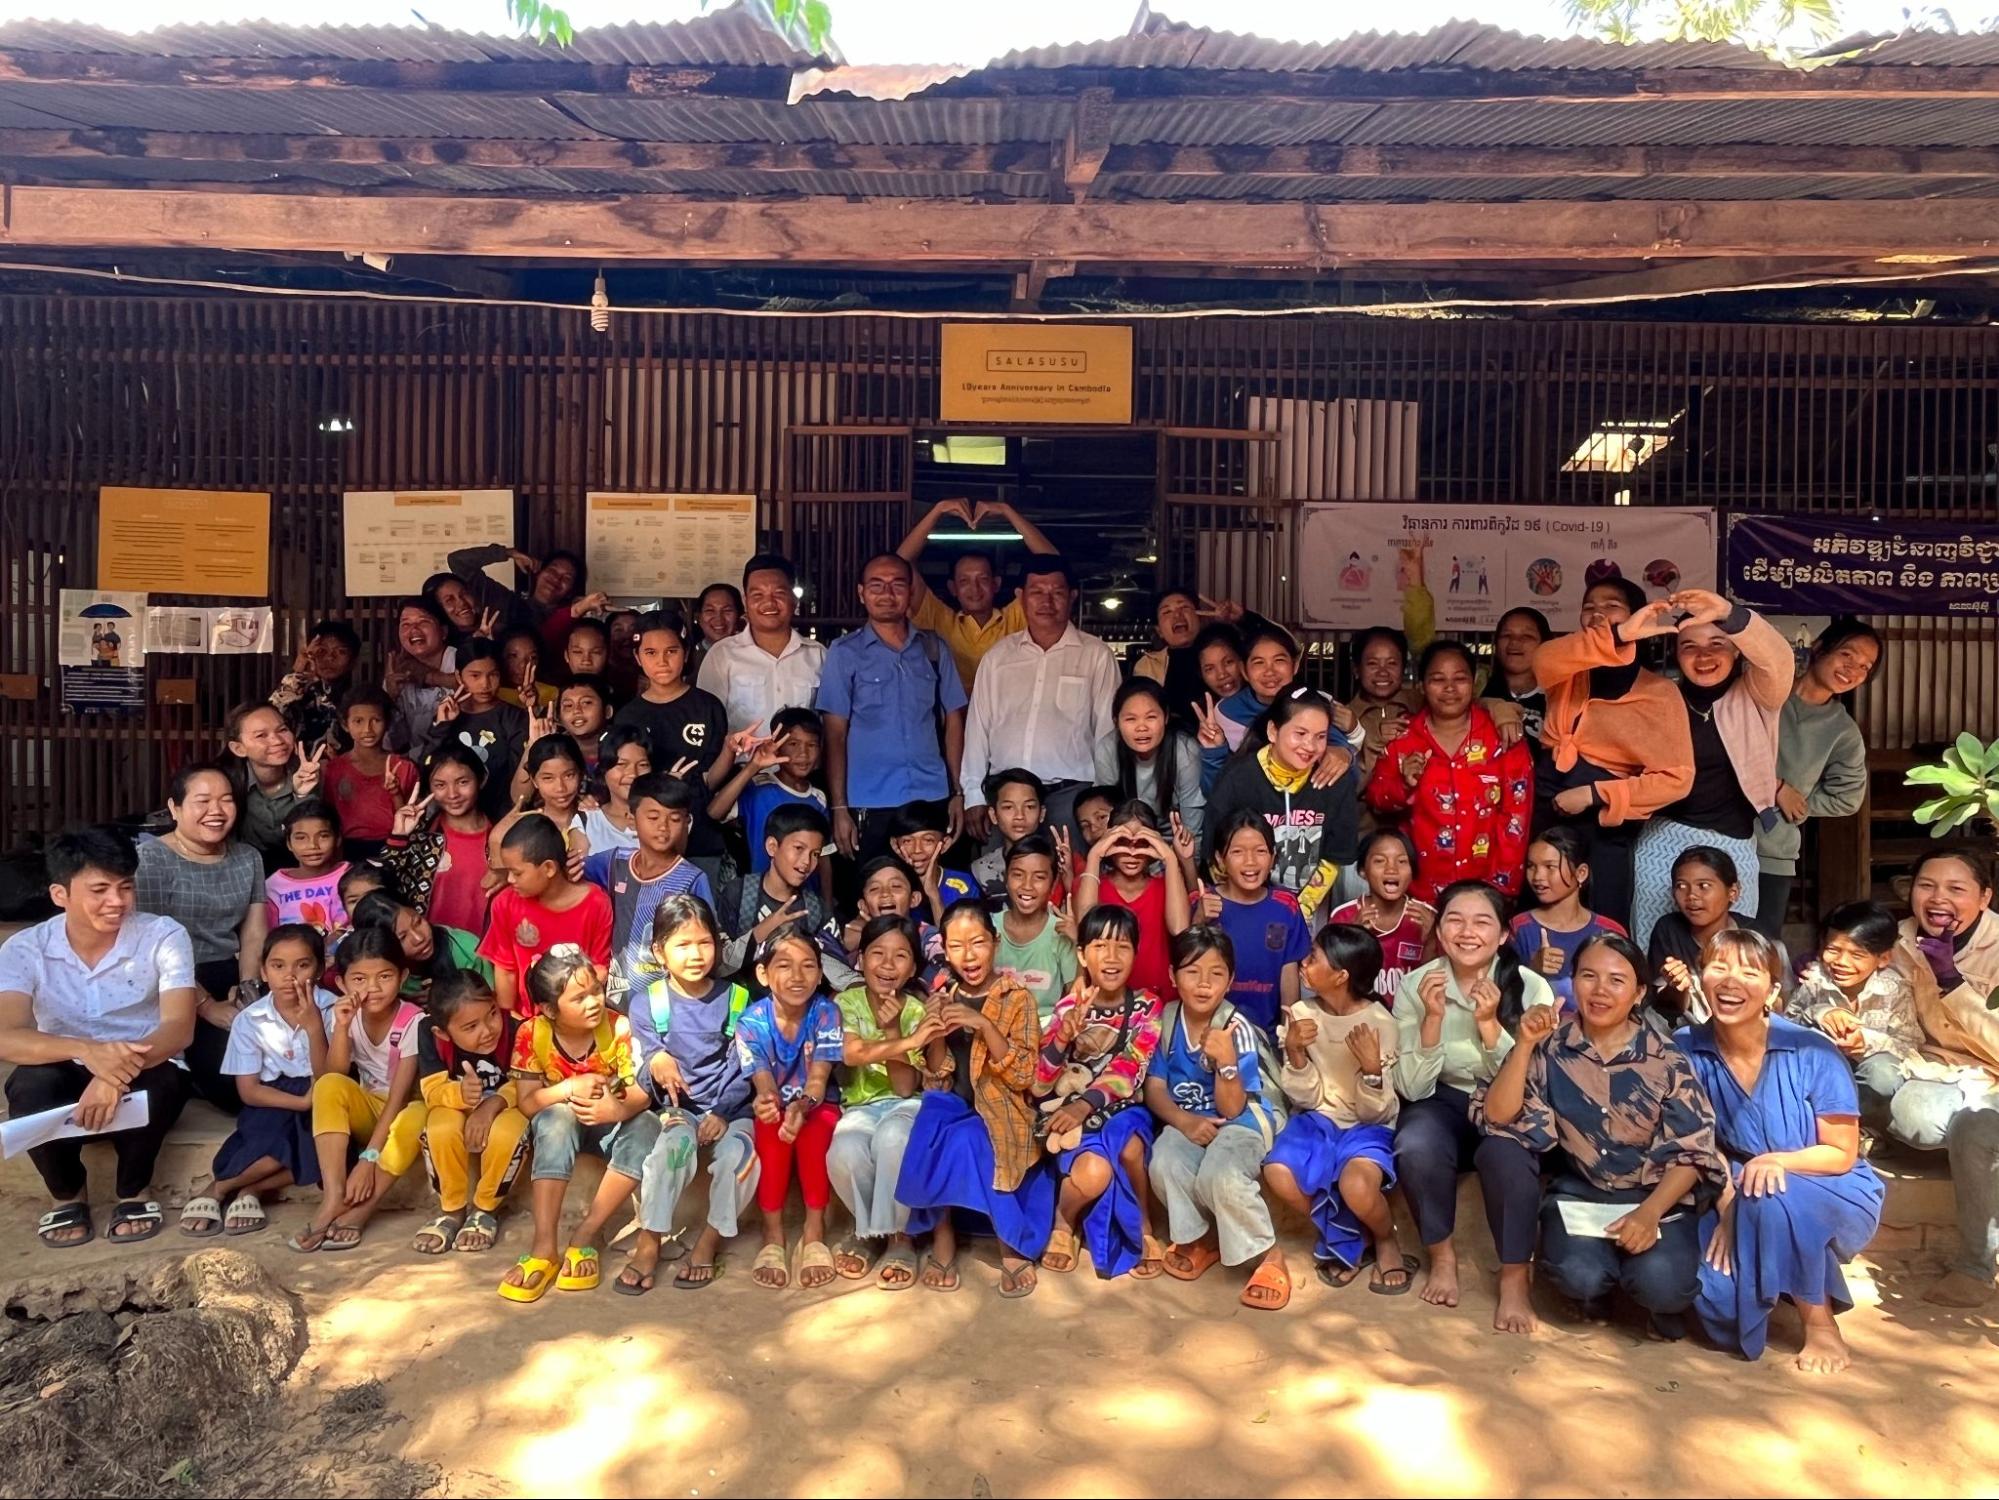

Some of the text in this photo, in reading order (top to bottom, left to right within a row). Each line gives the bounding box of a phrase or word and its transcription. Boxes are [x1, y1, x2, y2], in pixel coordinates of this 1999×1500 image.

[995, 356, 1079, 367] SALASUSU
[1000, 383, 1053, 393] Anniversary
[1057, 383, 1065, 392] in
[1069, 384, 1112, 393] Cambodia
[279, 886, 333, 904] THE DAY
